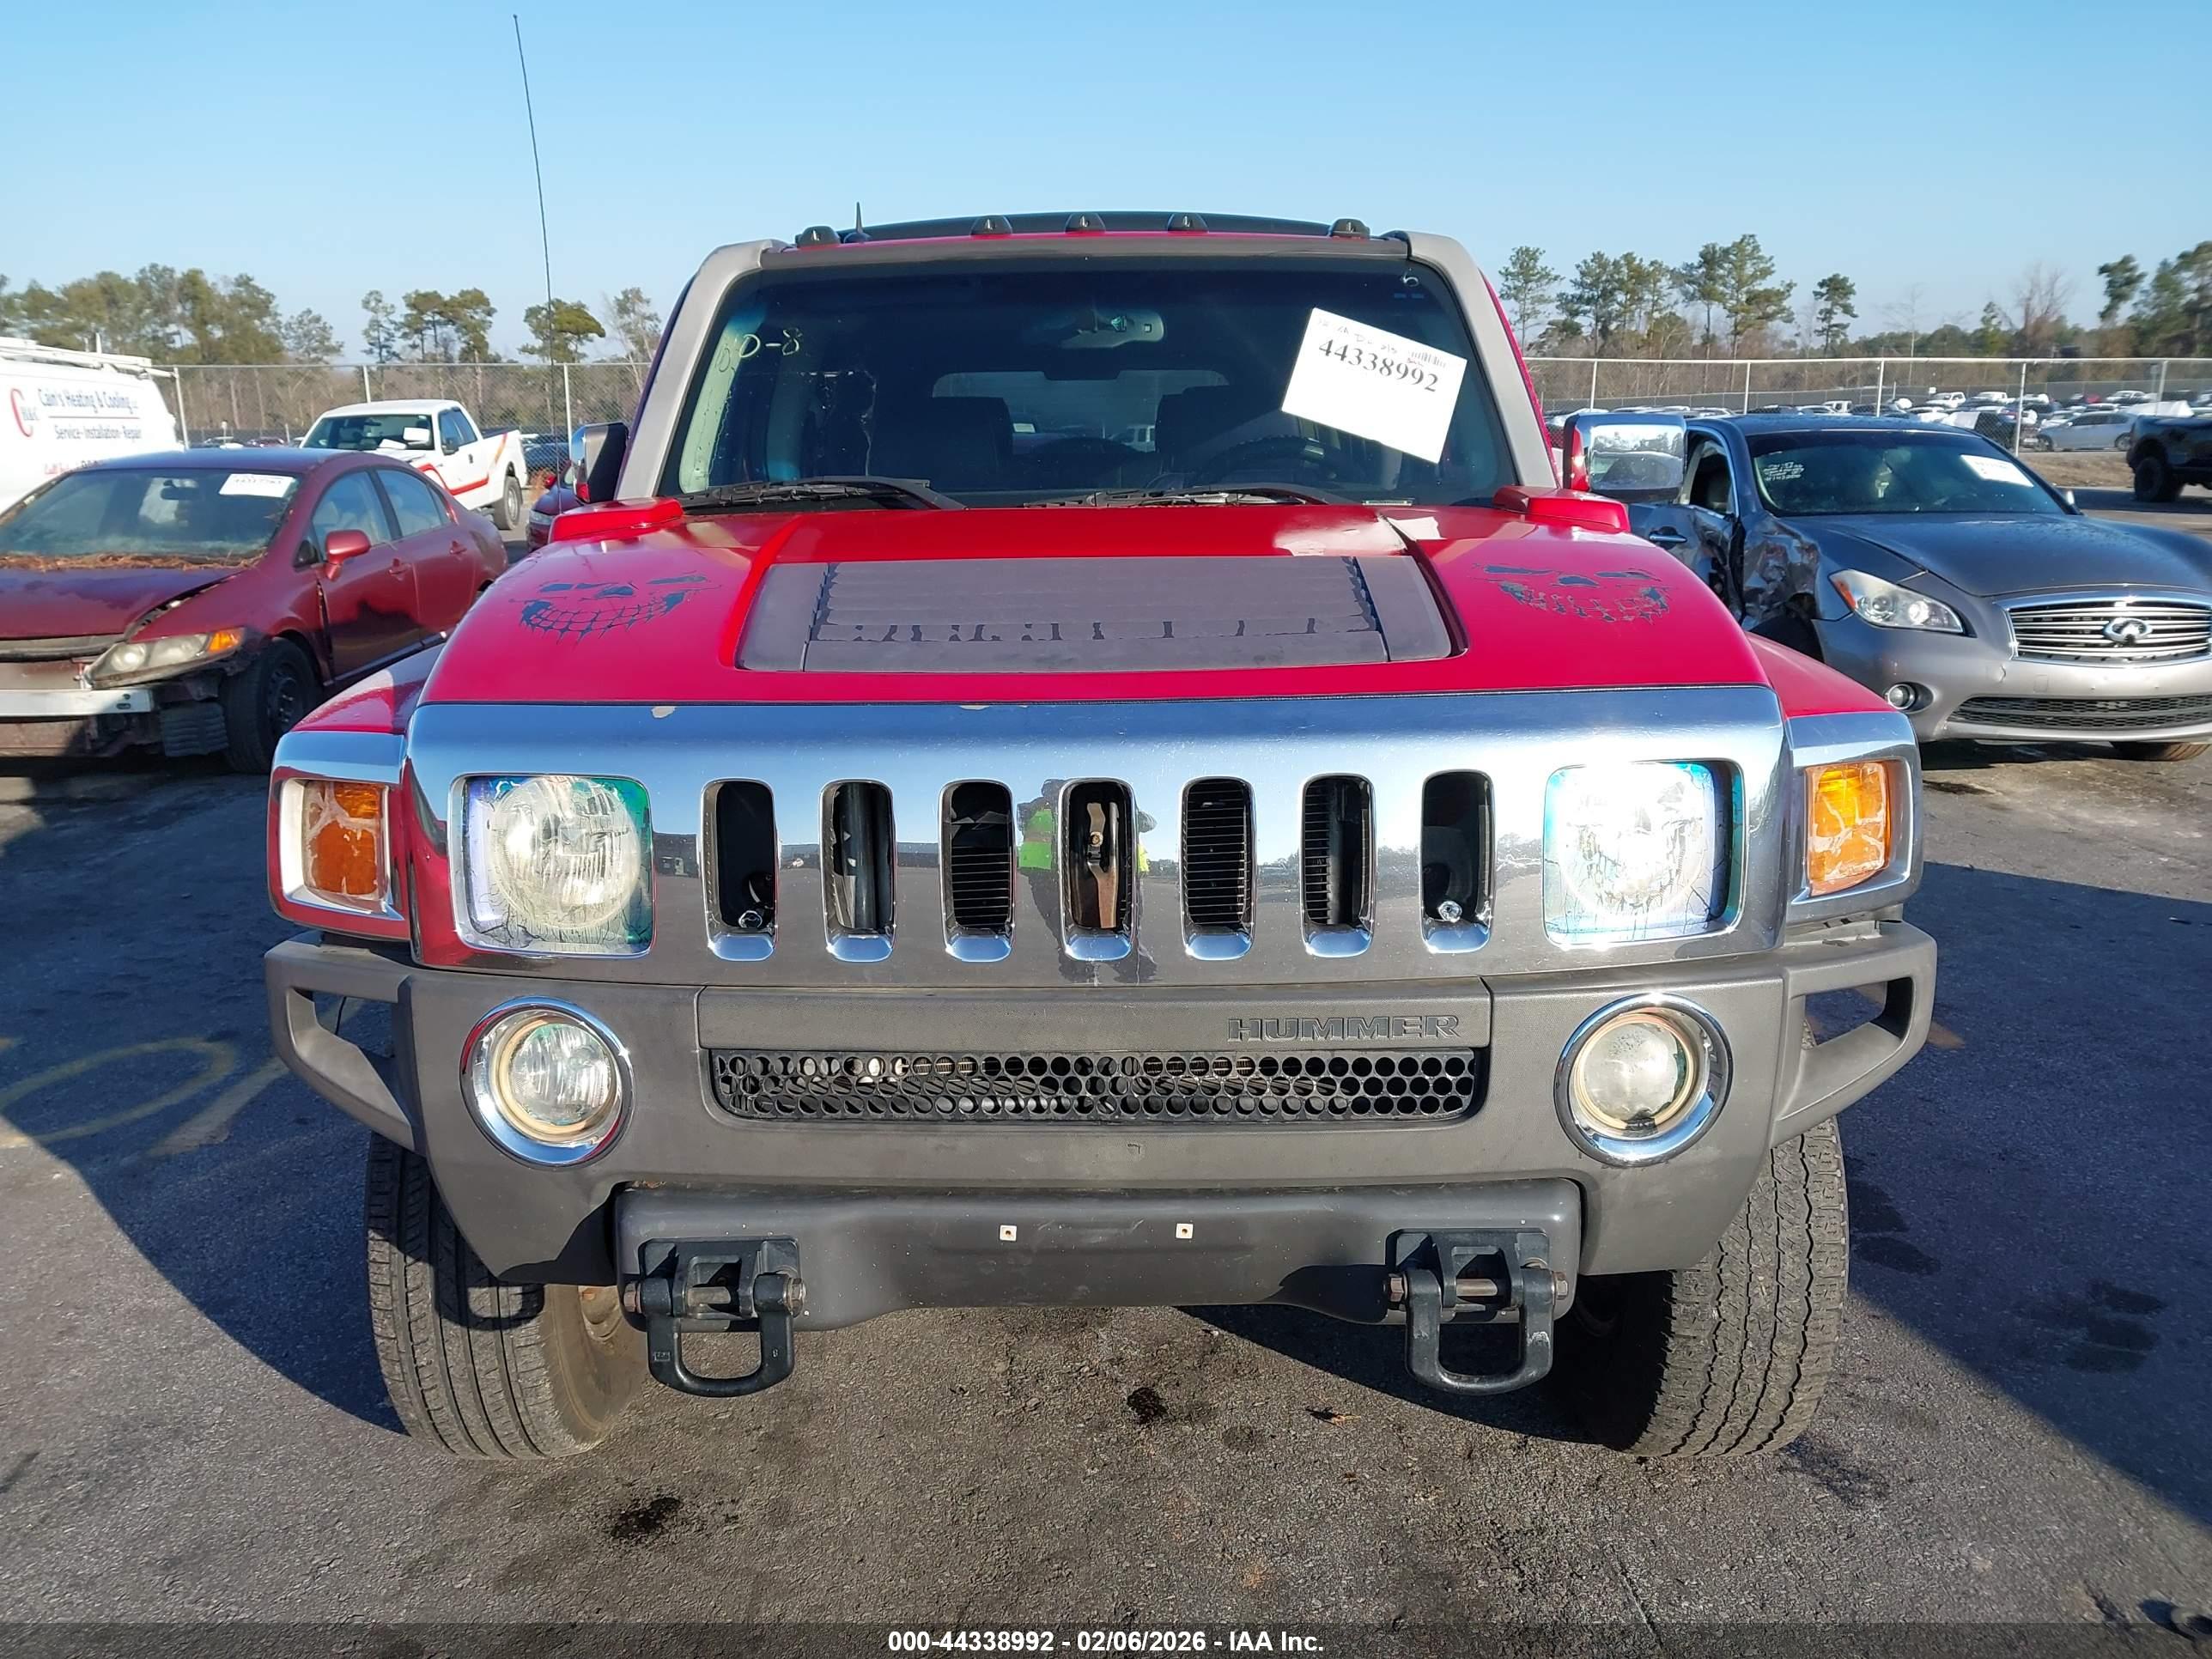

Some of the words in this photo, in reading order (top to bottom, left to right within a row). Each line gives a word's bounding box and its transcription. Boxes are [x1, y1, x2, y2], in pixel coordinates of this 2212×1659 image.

[1319, 338, 1438, 392] 44338992
[64, 390, 98, 413] Heating
[102, 391, 133, 414] Cooling
[123, 425, 142, 442] Repair
[1227, 1015, 1462, 1042] HUMMER
